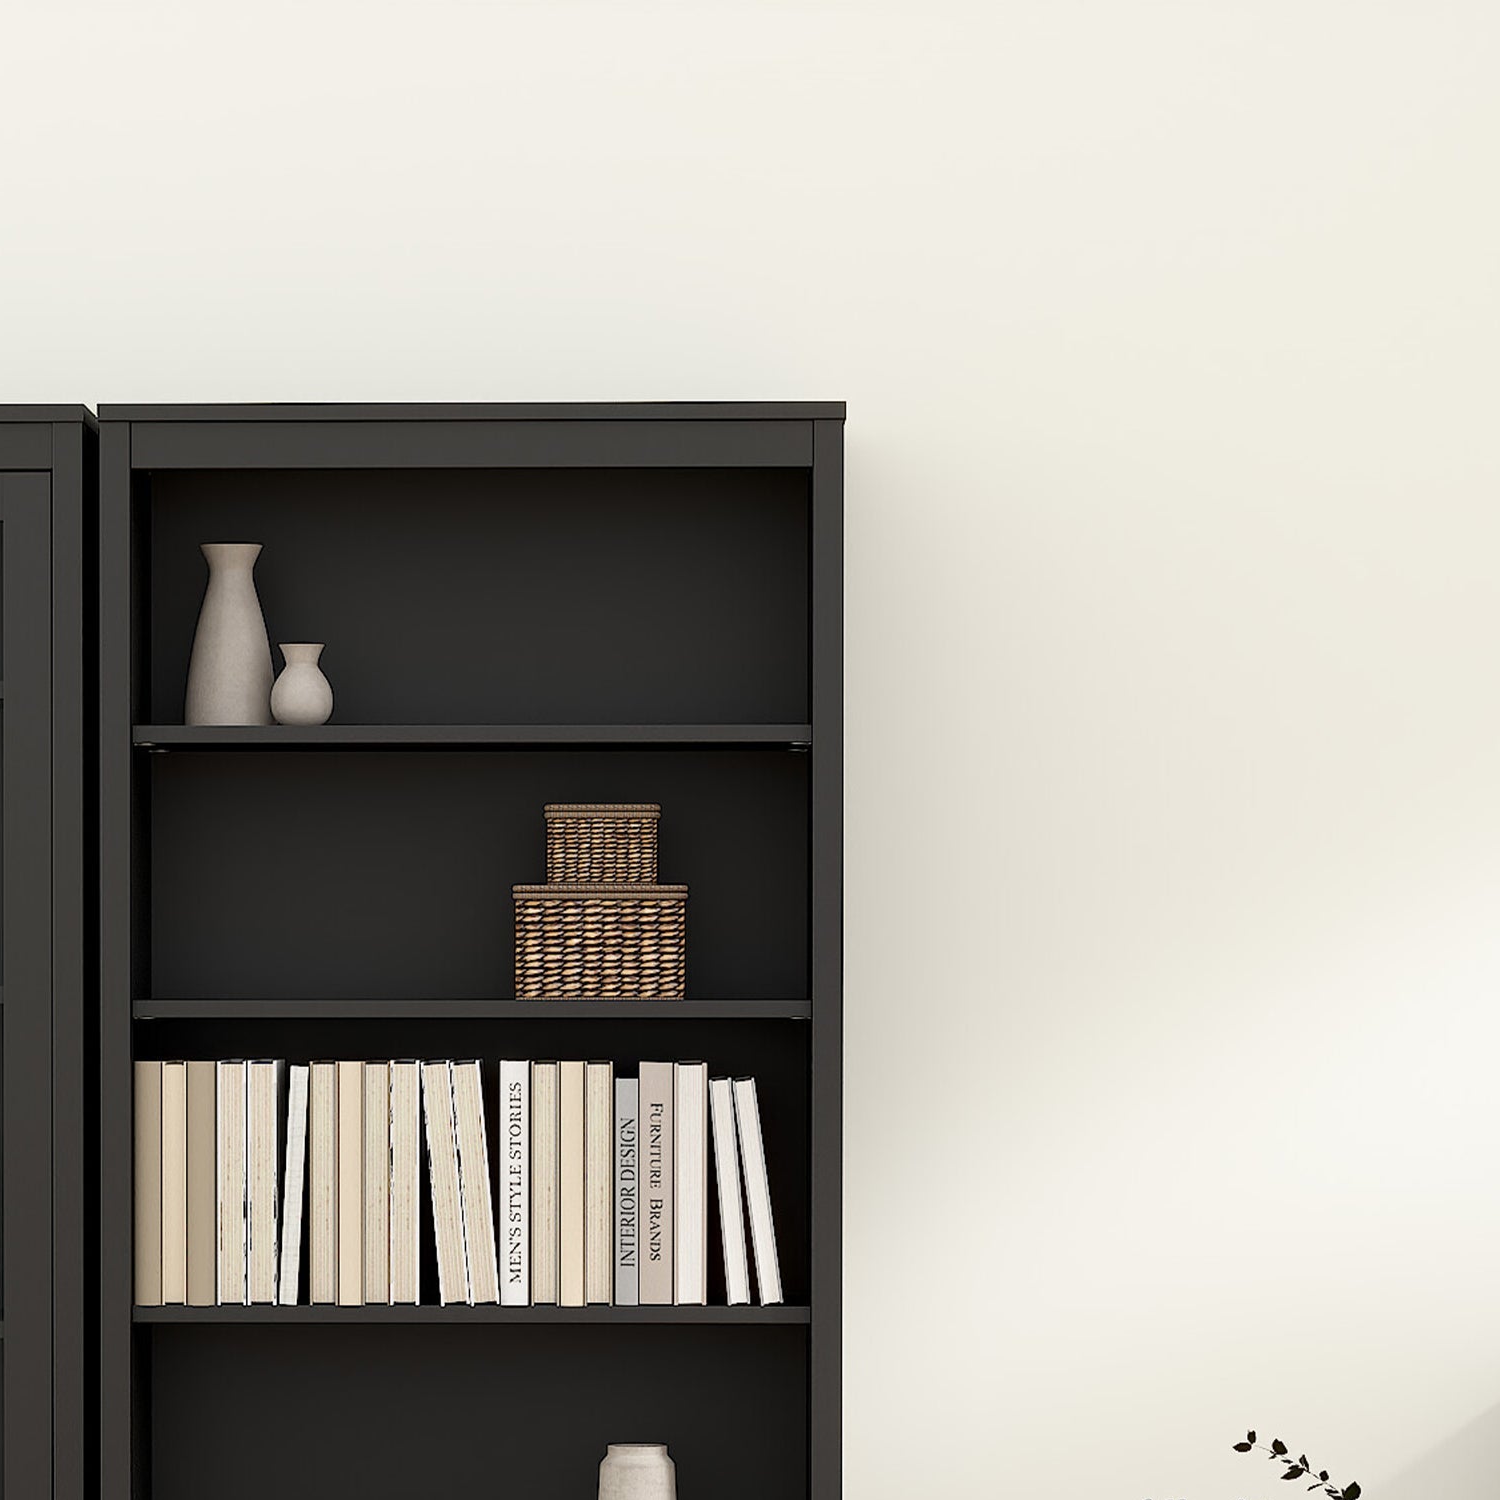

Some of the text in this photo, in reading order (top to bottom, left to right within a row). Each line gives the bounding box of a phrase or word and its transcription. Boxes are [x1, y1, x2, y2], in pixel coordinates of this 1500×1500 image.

[508, 1081, 522, 1284] MEN'S STYLE STORIES
[620, 1117, 636, 1268] INTERIOR DESIGN
[649, 1198, 664, 1262] BRANDS
